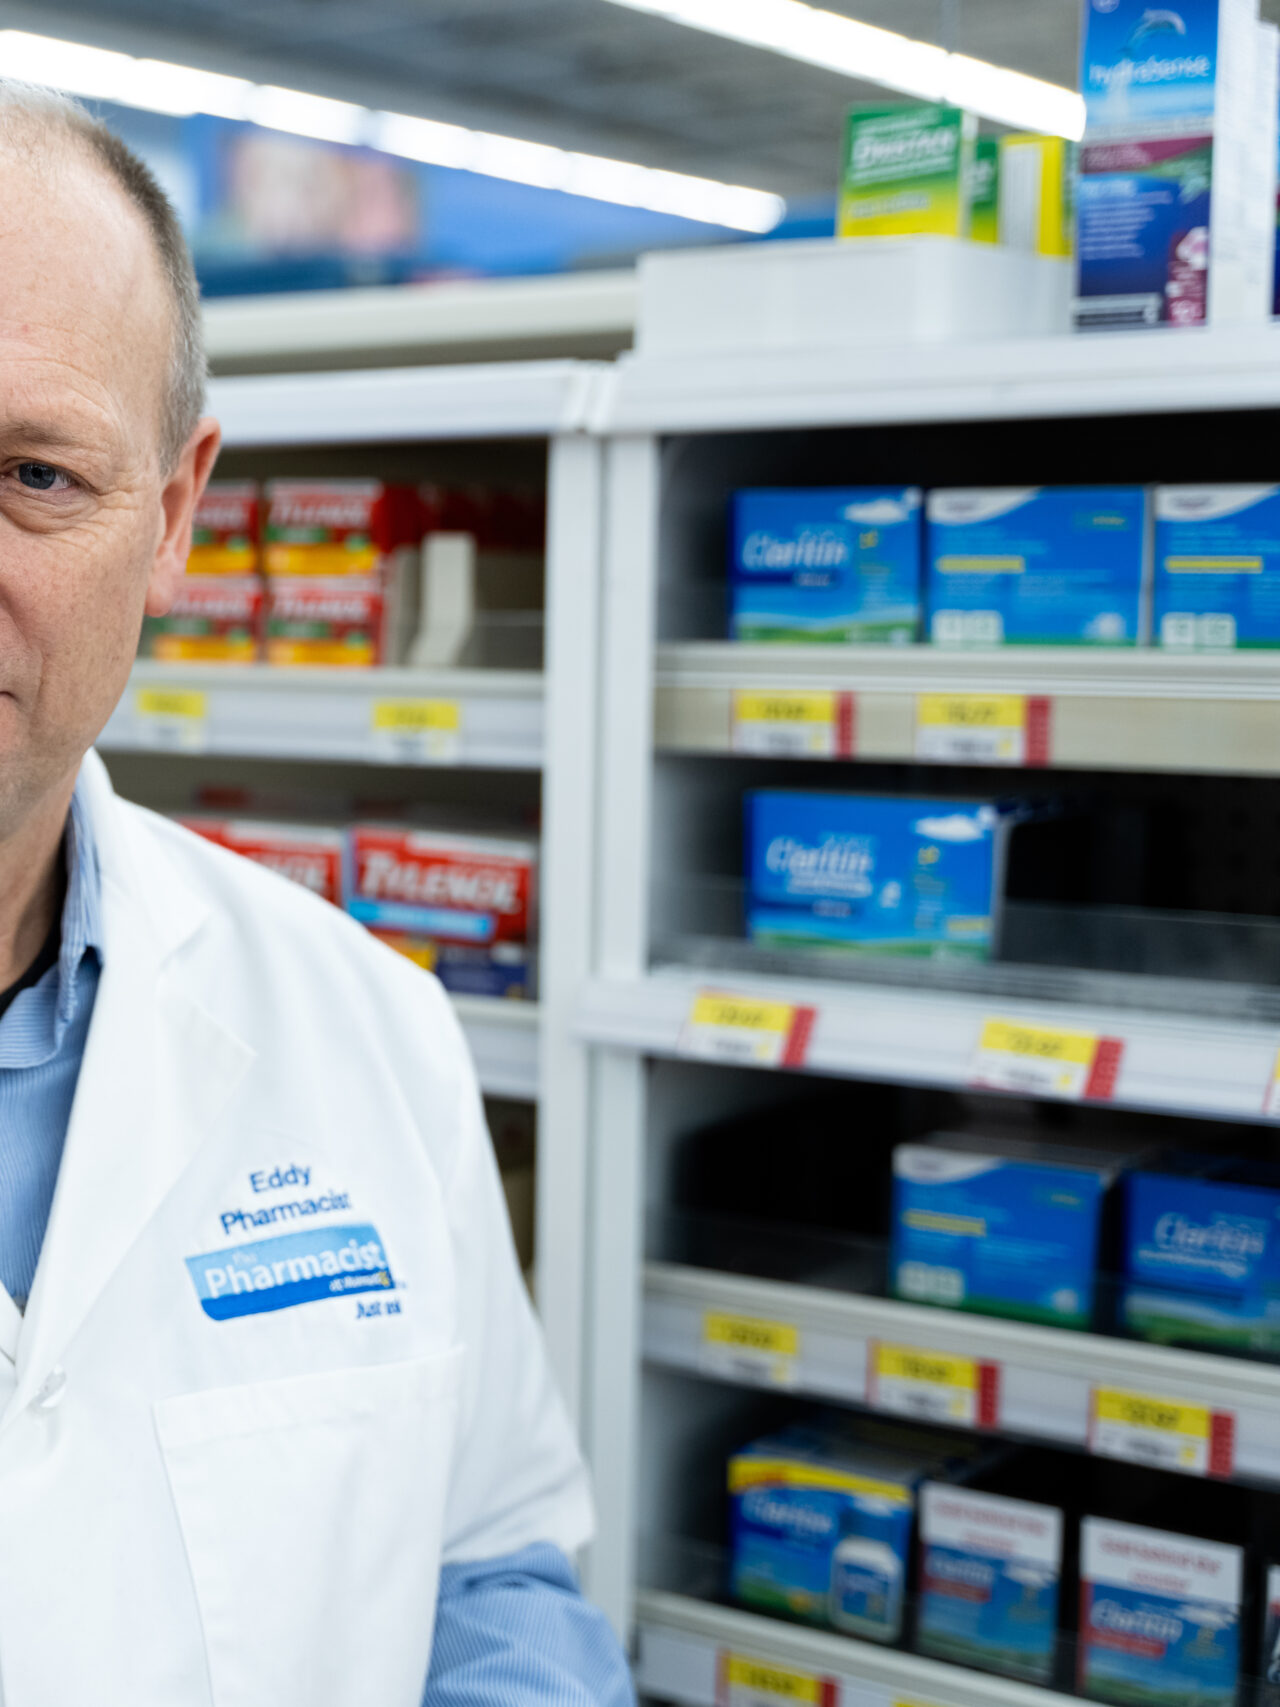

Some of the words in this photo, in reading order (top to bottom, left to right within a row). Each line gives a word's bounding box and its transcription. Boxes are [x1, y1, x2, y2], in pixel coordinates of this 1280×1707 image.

[249, 1163, 312, 1194] Eddy
[219, 1189, 353, 1236] Pharmacist
[204, 1238, 387, 1299] Pharmacist
